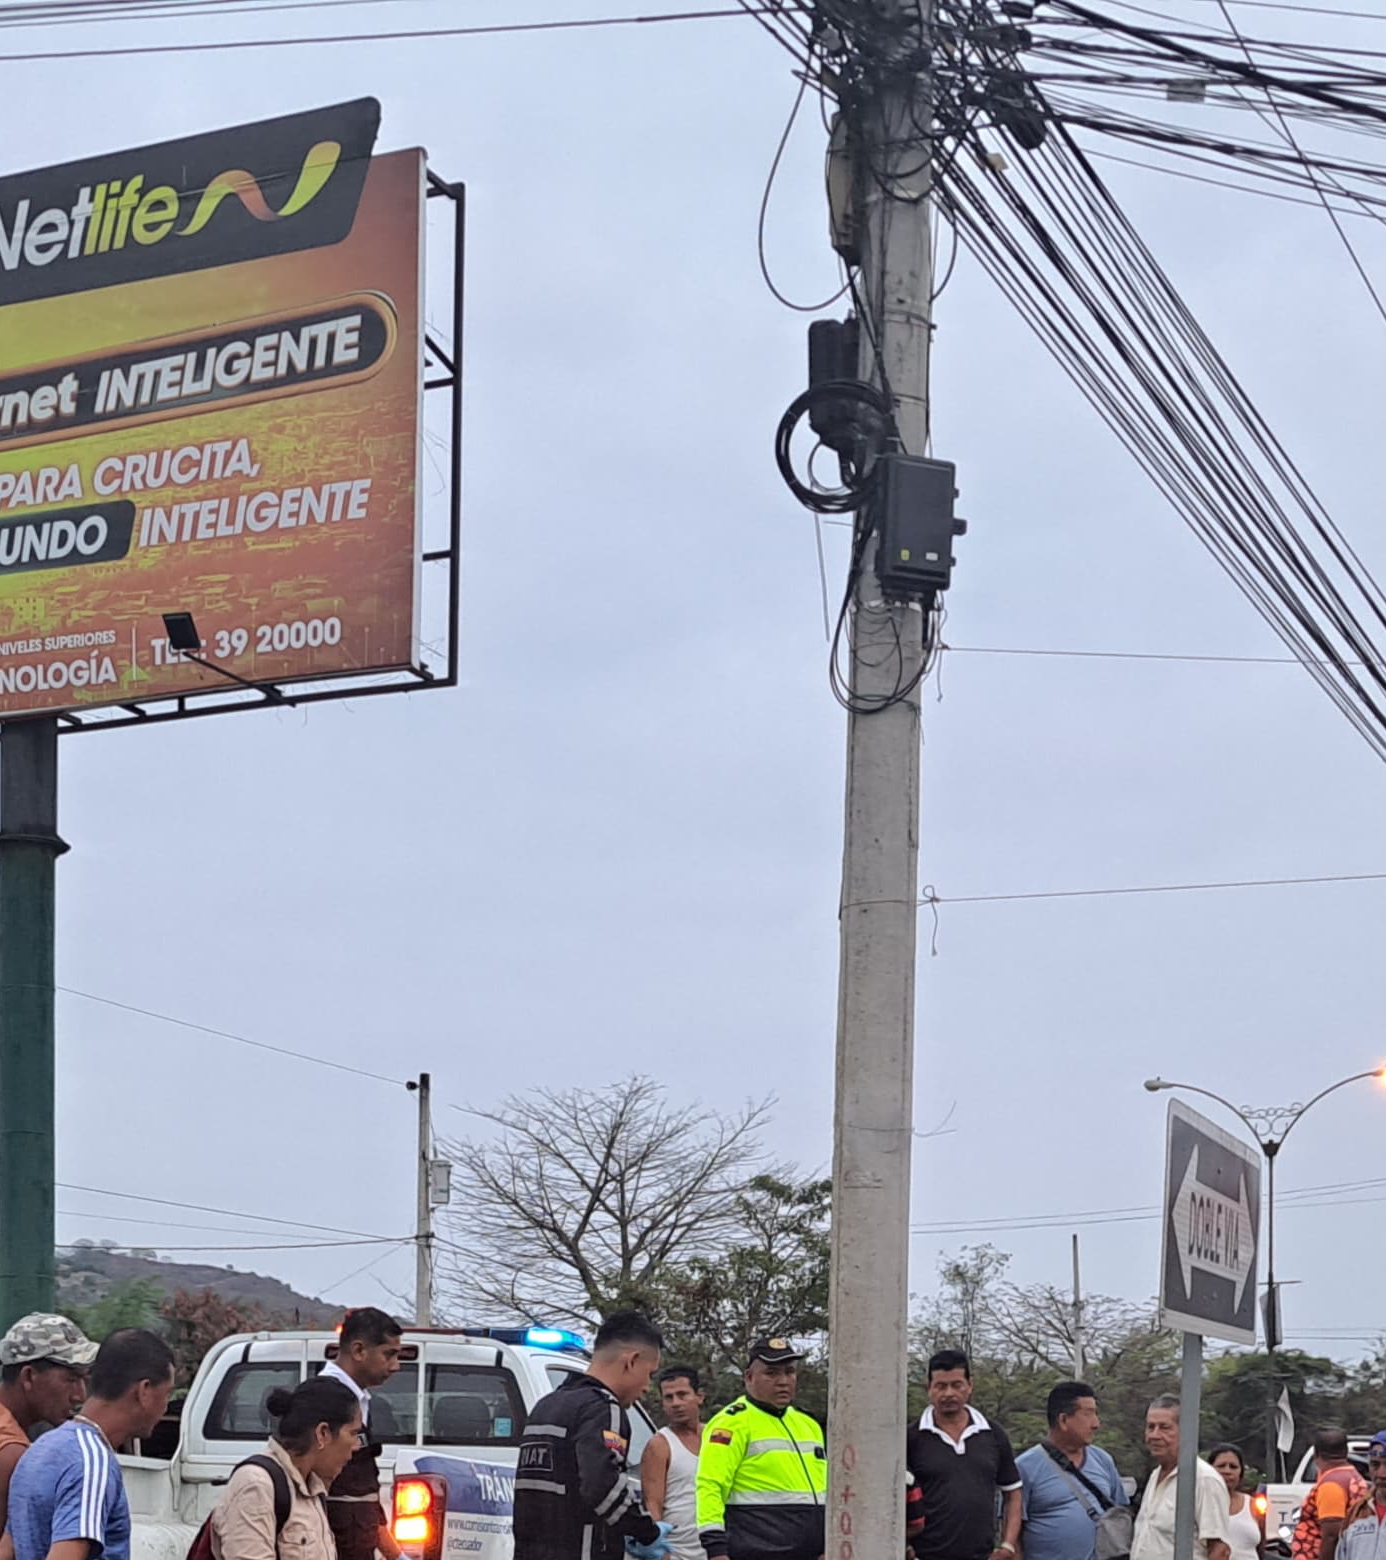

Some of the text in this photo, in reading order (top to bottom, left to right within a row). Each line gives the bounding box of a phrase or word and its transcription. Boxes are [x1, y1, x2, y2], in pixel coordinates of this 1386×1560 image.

[93, 314, 362, 414] INTELIGENTE
[93, 438, 262, 494] CRUCITA,
[138, 478, 373, 548] INTELIGENTE
[43, 629, 117, 652] SUPERIORES
[214, 627, 249, 658] 39
[255, 616, 342, 653] 20000
[1188, 1191, 1223, 1265] DOBLE
